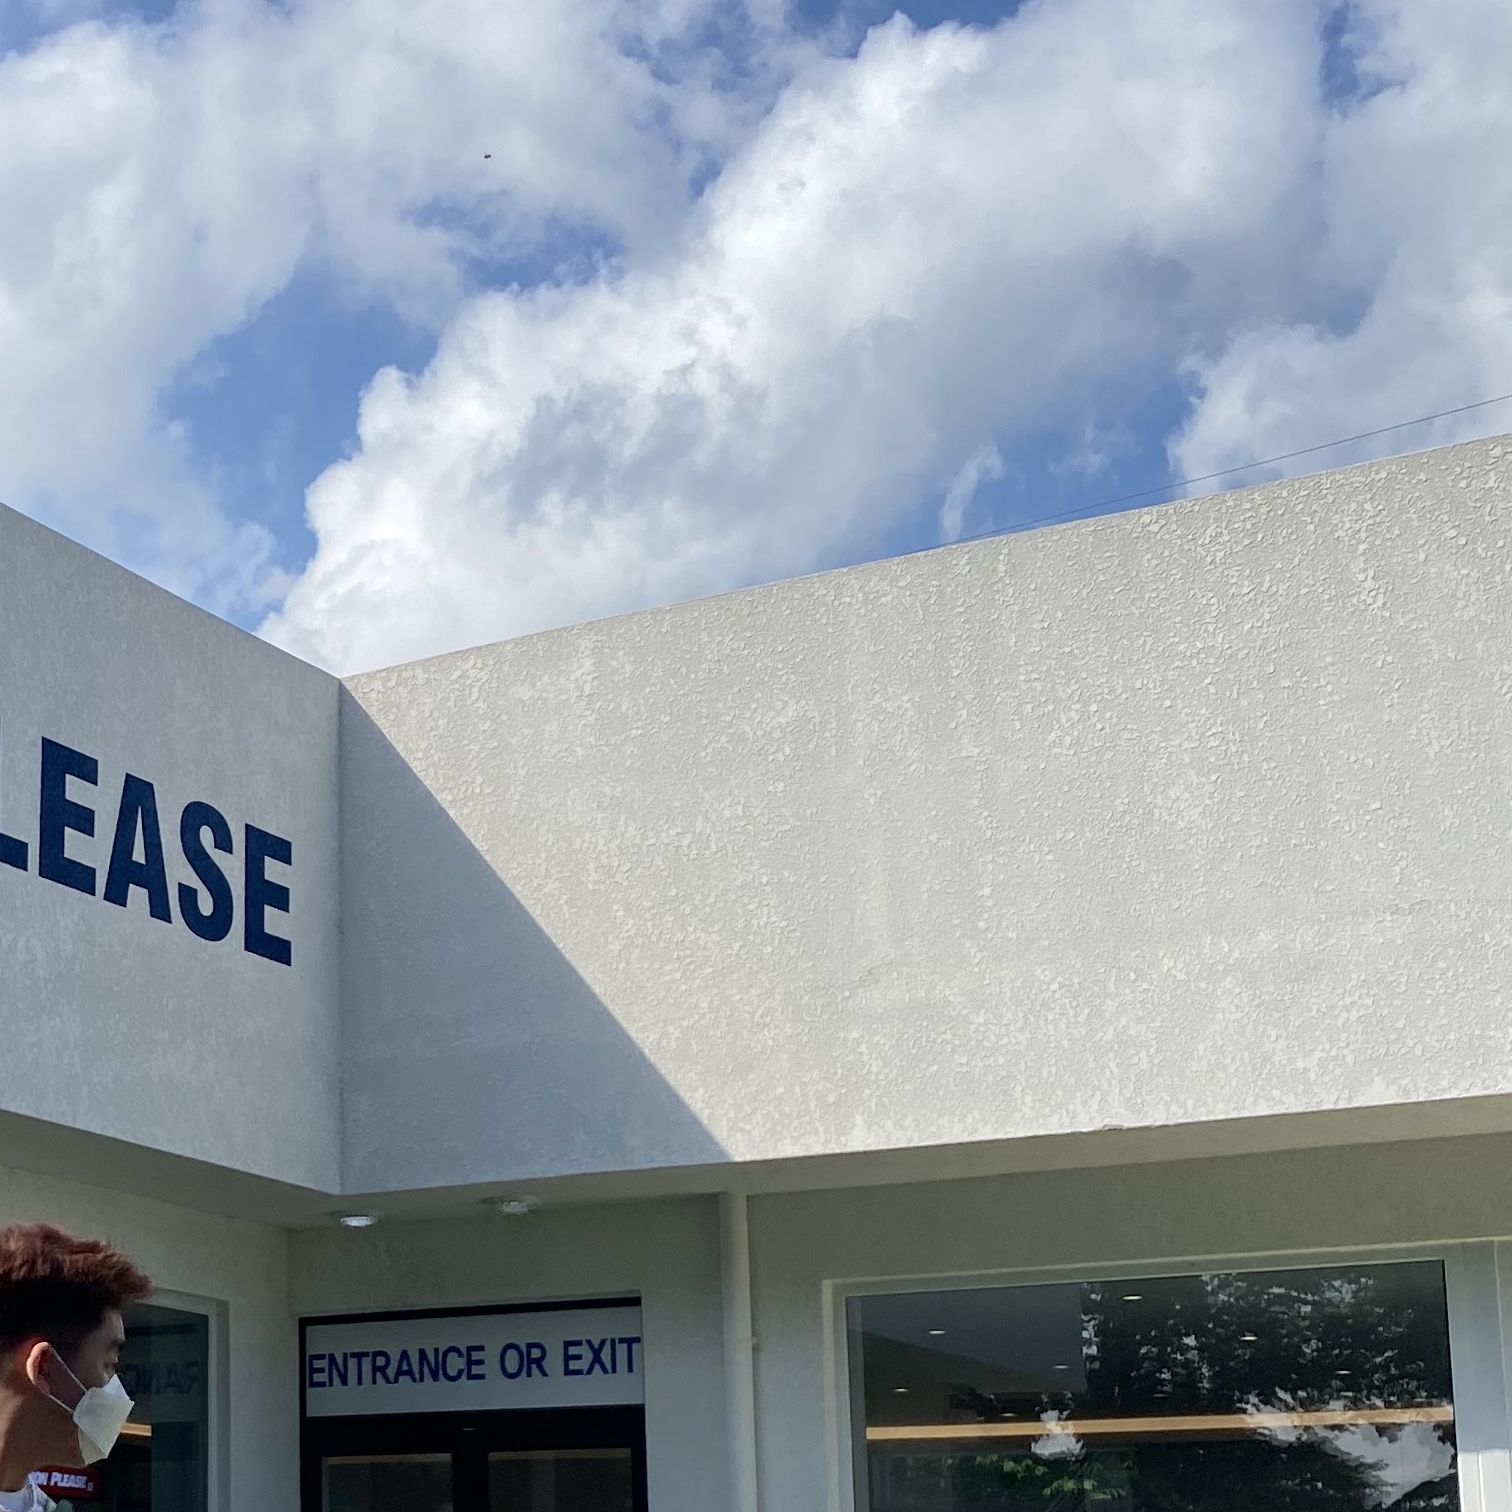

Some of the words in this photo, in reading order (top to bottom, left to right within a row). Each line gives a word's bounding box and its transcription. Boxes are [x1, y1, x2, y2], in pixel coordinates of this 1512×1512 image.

[307, 1345, 487, 1389] ENTRANCE
[499, 1341, 549, 1380] OR
[562, 1336, 642, 1377] EXIT
